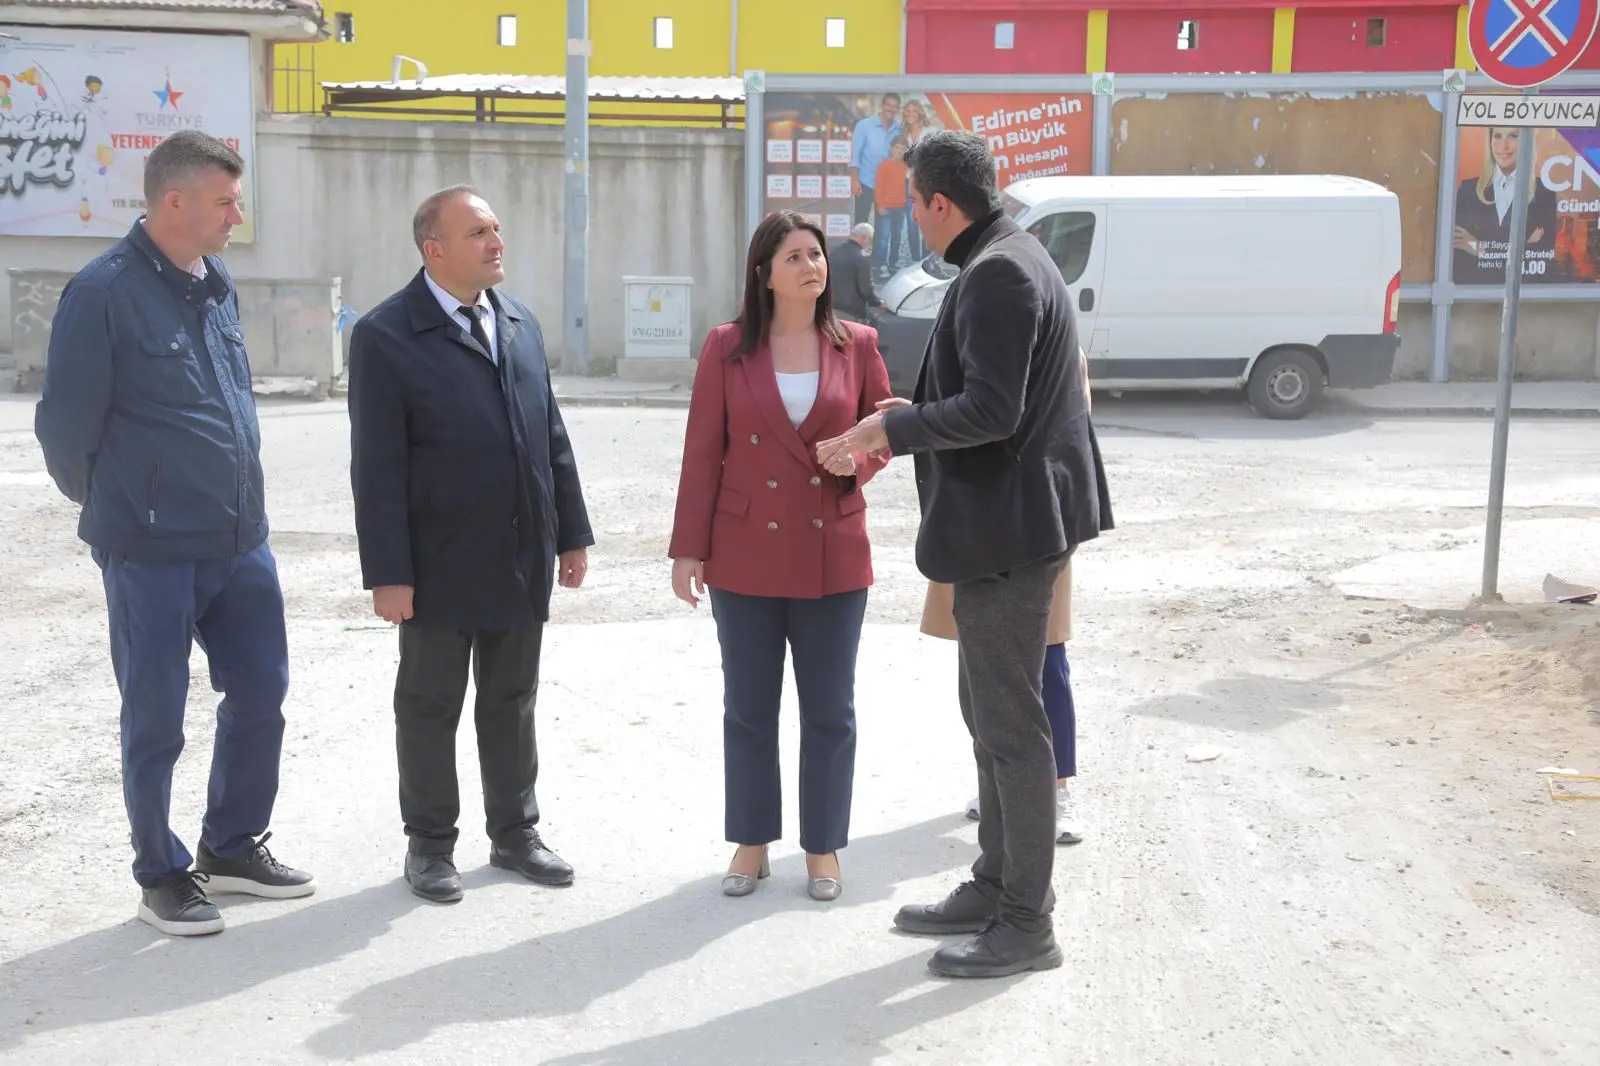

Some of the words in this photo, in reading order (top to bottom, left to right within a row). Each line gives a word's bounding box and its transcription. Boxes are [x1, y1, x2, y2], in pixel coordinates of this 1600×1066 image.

[972, 96, 1082, 133] Edirne'nin
[1463, 102, 1496, 119] YOL
[1504, 102, 1595, 120] BOYUNCA
[986, 134, 1004, 151] n
[1006, 121, 1067, 147] Büyük
[993, 154, 1010, 170] n
[1014, 145, 1068, 166] Hesaplı
[1557, 199, 1600, 213] Günd
[1525, 249, 1555, 260] Strateji
